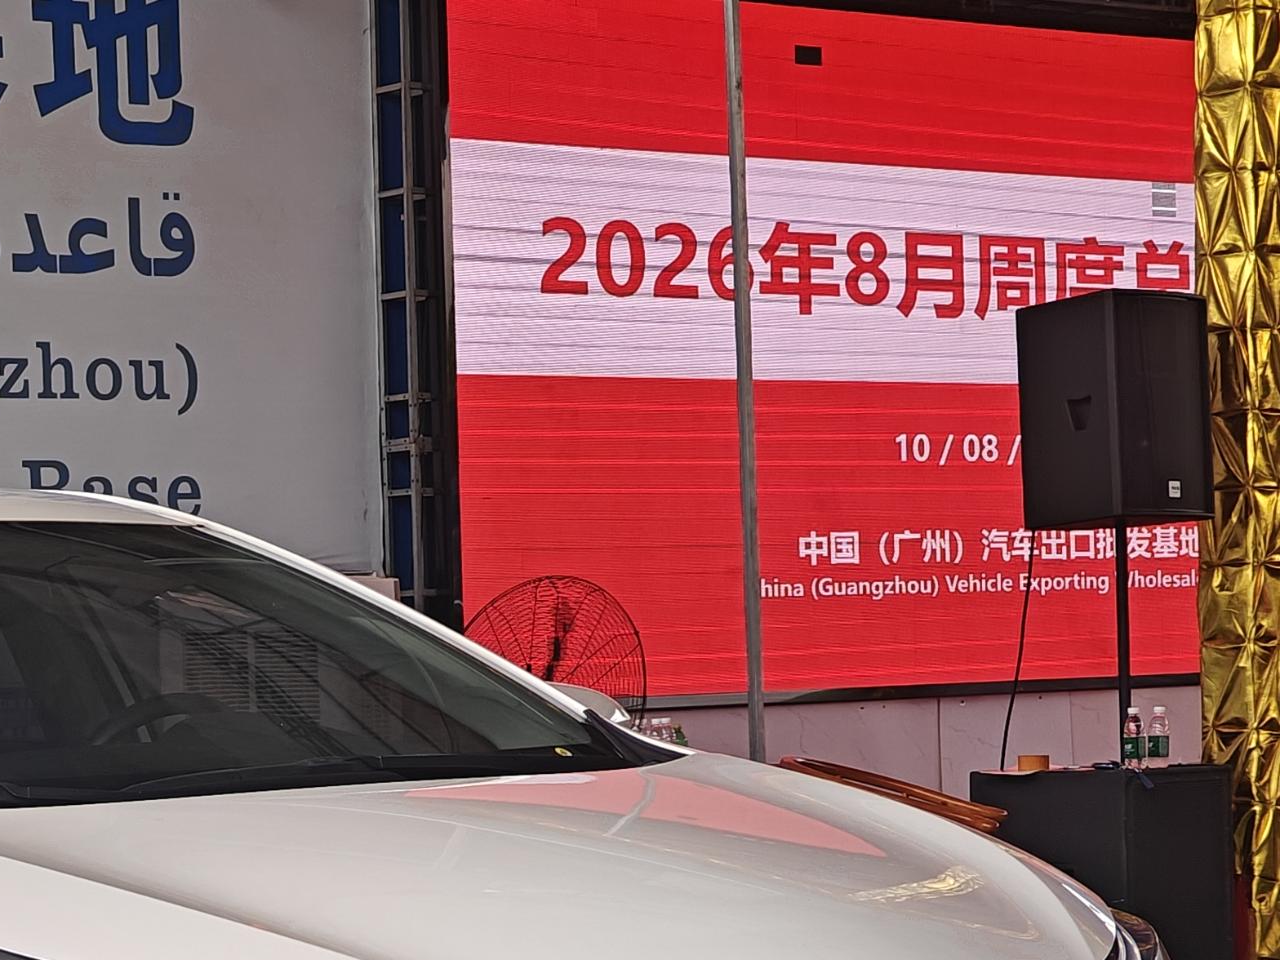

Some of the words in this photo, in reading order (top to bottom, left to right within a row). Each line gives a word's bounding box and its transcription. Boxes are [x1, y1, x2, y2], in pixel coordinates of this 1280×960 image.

[895, 433, 931, 463] 10
[963, 433, 999, 463] 08
[760, 577, 805, 598] hina
[811, 574, 939, 601] (Guangzhou)
[944, 572, 1013, 595] Vehicle
[1019, 571, 1110, 596] Exporting
[1114, 568, 1199, 588] holesal
